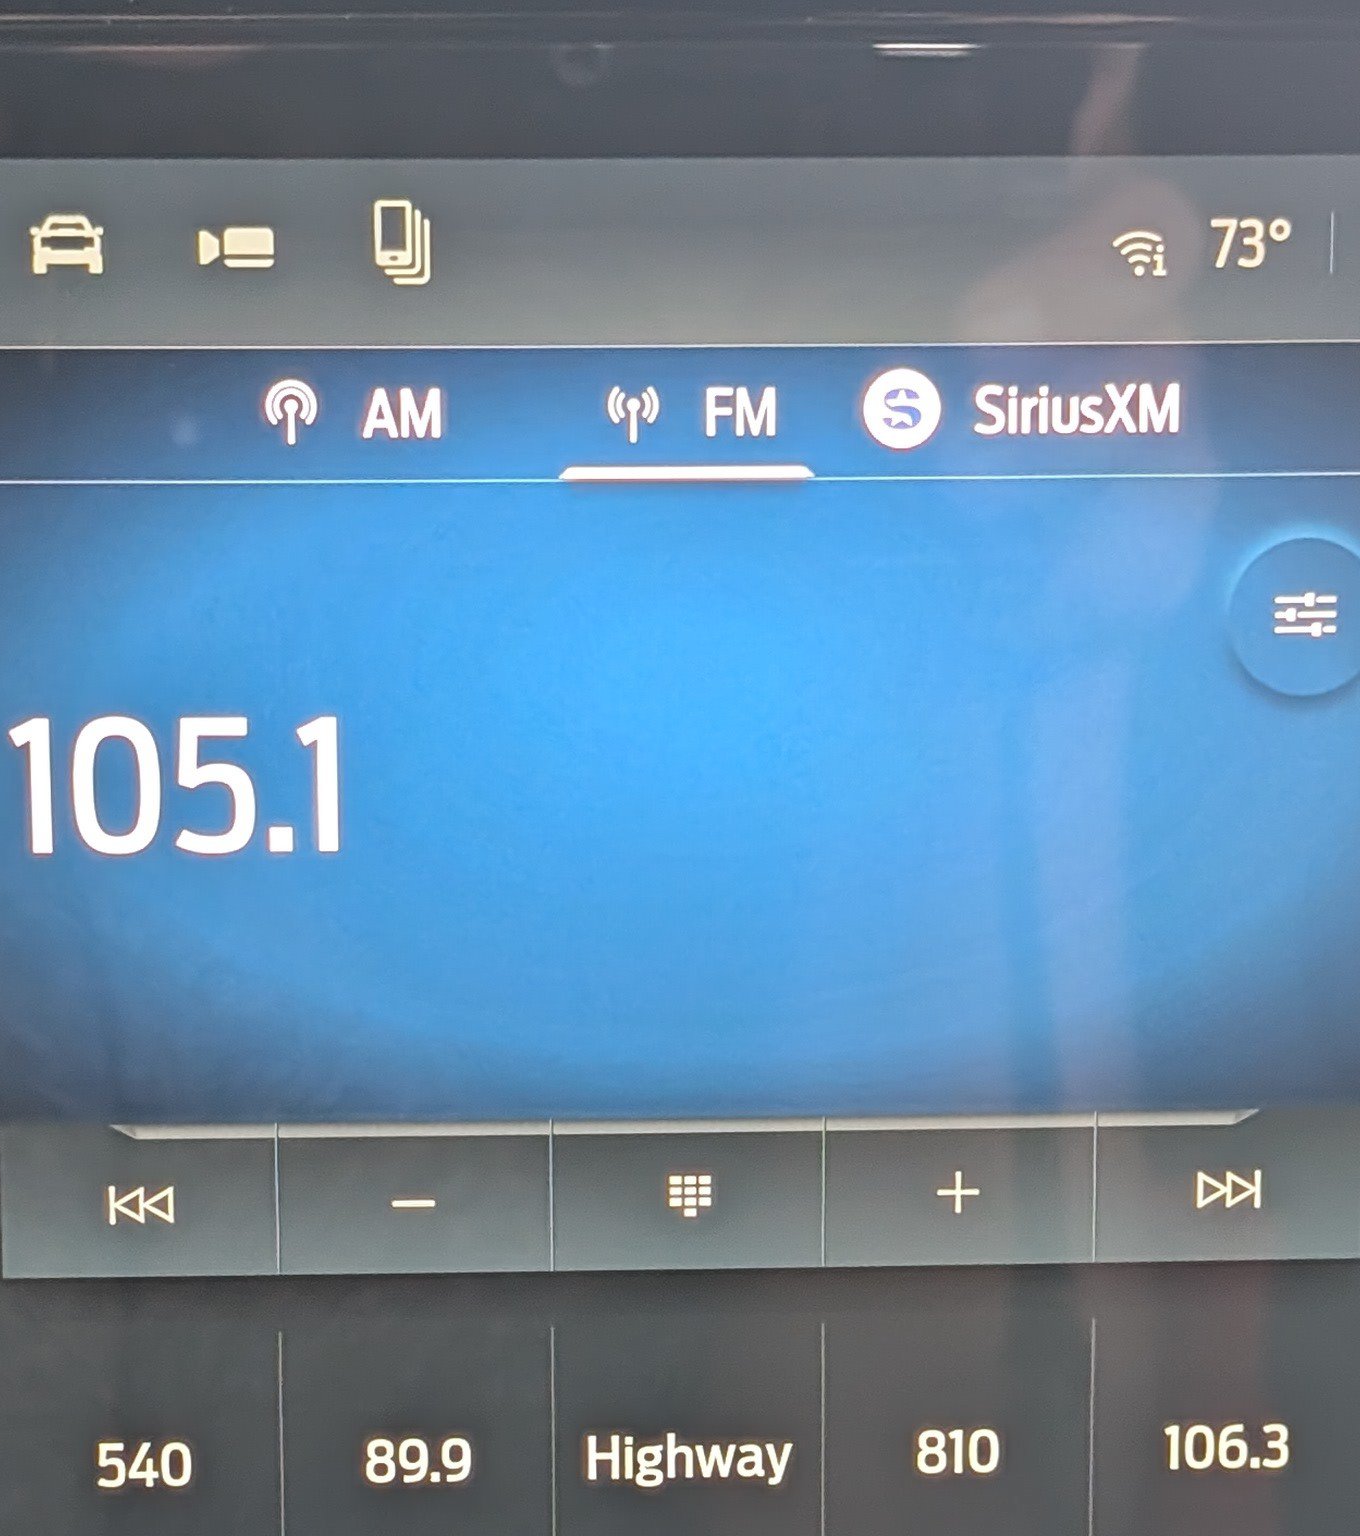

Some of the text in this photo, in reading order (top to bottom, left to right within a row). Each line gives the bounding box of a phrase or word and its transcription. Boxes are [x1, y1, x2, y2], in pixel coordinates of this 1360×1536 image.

[1210, 218, 1292, 269] 73°
[362, 387, 442, 439] AM
[705, 386, 777, 437] FM
[973, 382, 1180, 435] SiriusXM
[8, 715, 339, 855] 105.1
[97, 1441, 192, 1488] 540
[365, 1437, 472, 1484] 89.9
[587, 1432, 794, 1488] Highway
[917, 1428, 1000, 1474] 810
[1164, 1423, 1289, 1471] 106.3
